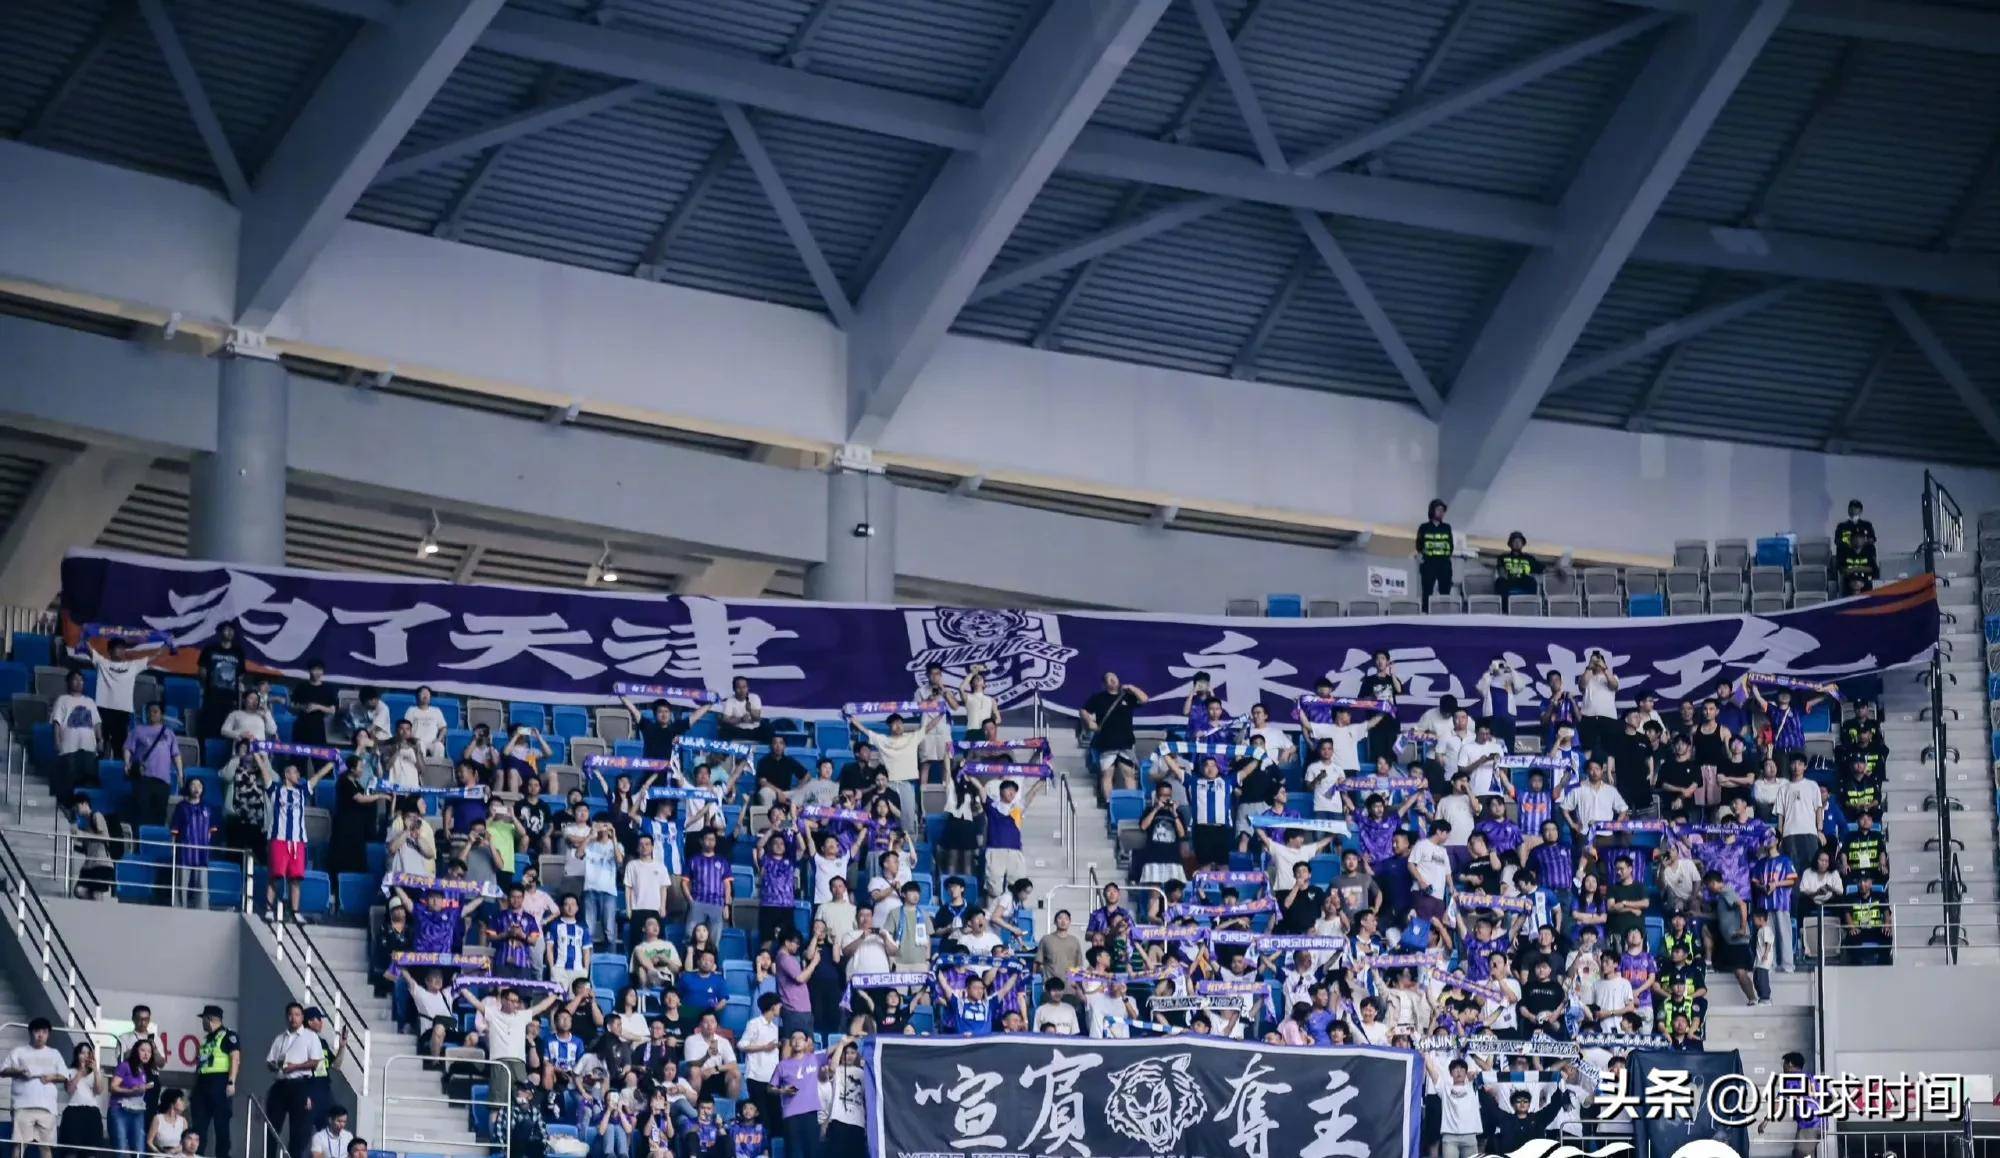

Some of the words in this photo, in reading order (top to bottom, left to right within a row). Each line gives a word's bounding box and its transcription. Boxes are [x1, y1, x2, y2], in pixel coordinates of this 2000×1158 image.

[126, 568, 805, 701] 为了天津
[912, 639, 1007, 669] JINMEN
[1001, 637, 1073, 660] TIGER
